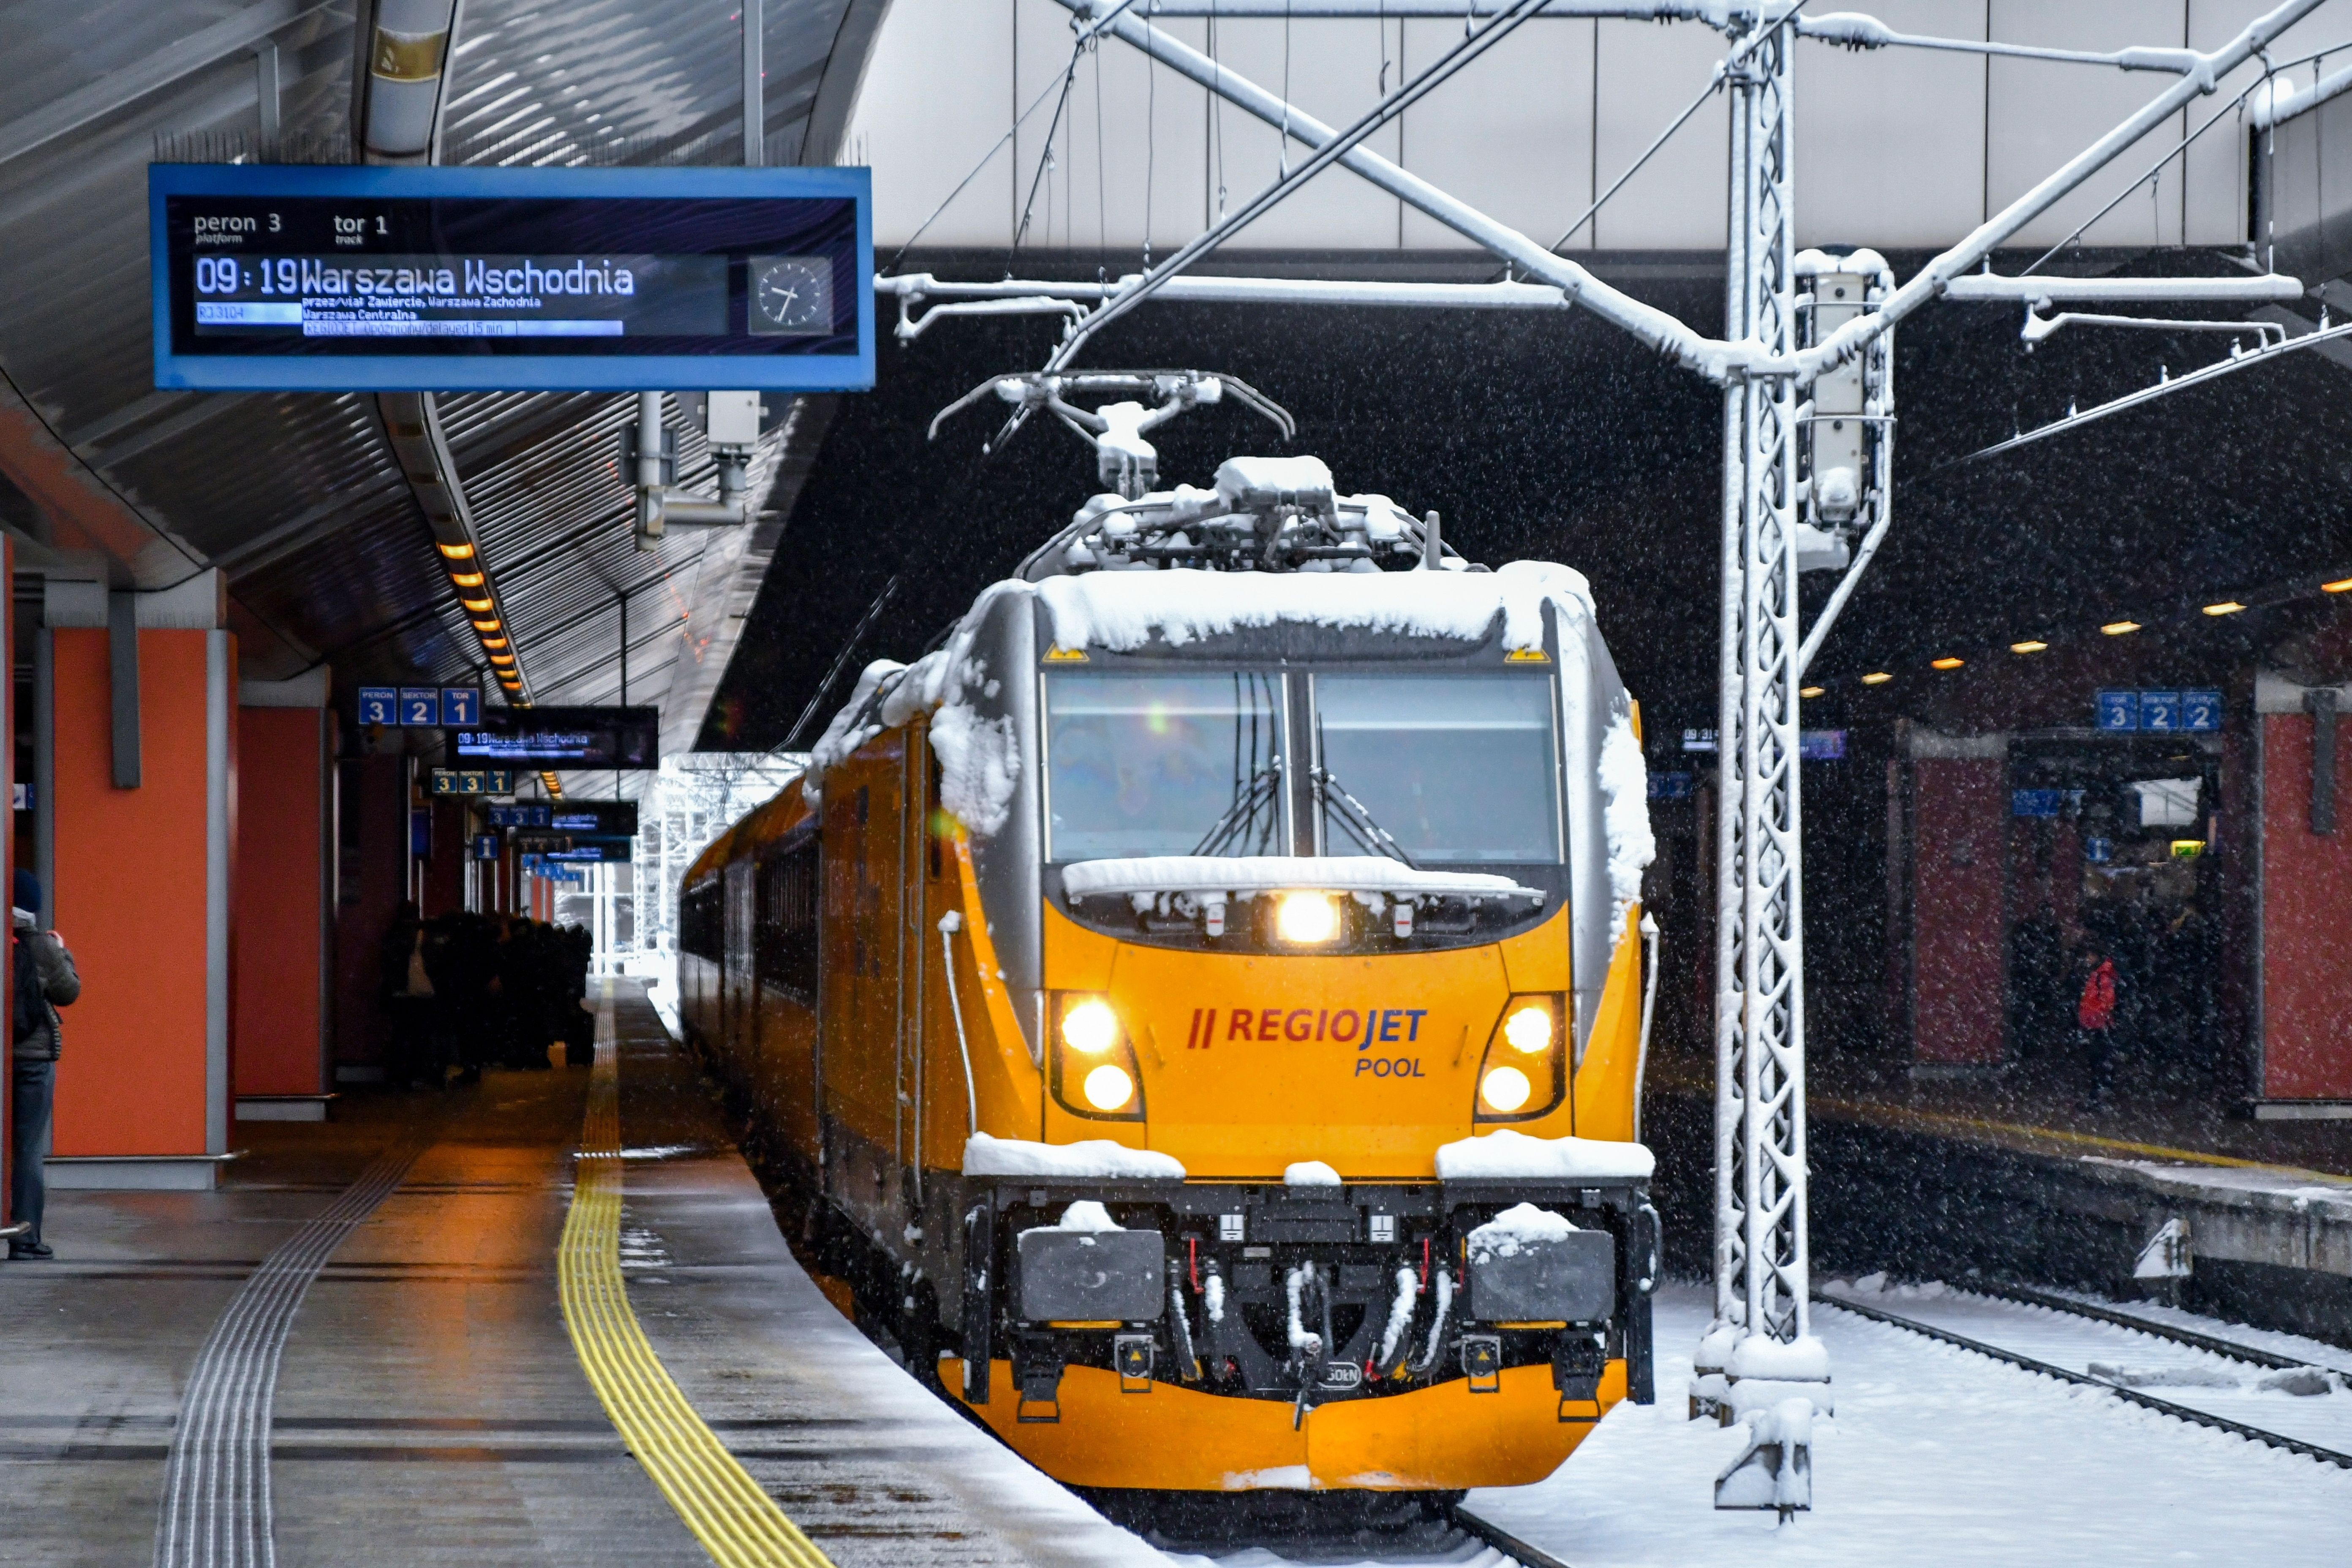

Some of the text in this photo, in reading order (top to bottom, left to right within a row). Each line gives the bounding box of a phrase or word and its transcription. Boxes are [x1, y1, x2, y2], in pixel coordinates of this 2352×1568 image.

[194, 212, 281, 234] peron 3
[334, 215, 388, 234] tor 1
[196, 233, 243, 245] platform
[335, 234, 364, 245] track
[301, 258, 456, 294] Warszawa
[464, 259, 634, 294] Wschodnia
[427, 296, 482, 308] Warszawa
[483, 296, 542, 308] Zachodnia
[302, 309, 418, 321] Warszawa Centralna
[473, 321, 482, 334] 15
[486, 321, 503, 335] min
[369, 702, 466, 721] 3 2 1
[2111, 706, 2209, 726] 3 2 2
[439, 777, 503, 791] 3 3 1
[1227, 1008, 1428, 1051] REGIOJET
[1355, 1058, 1426, 1077] POOL
